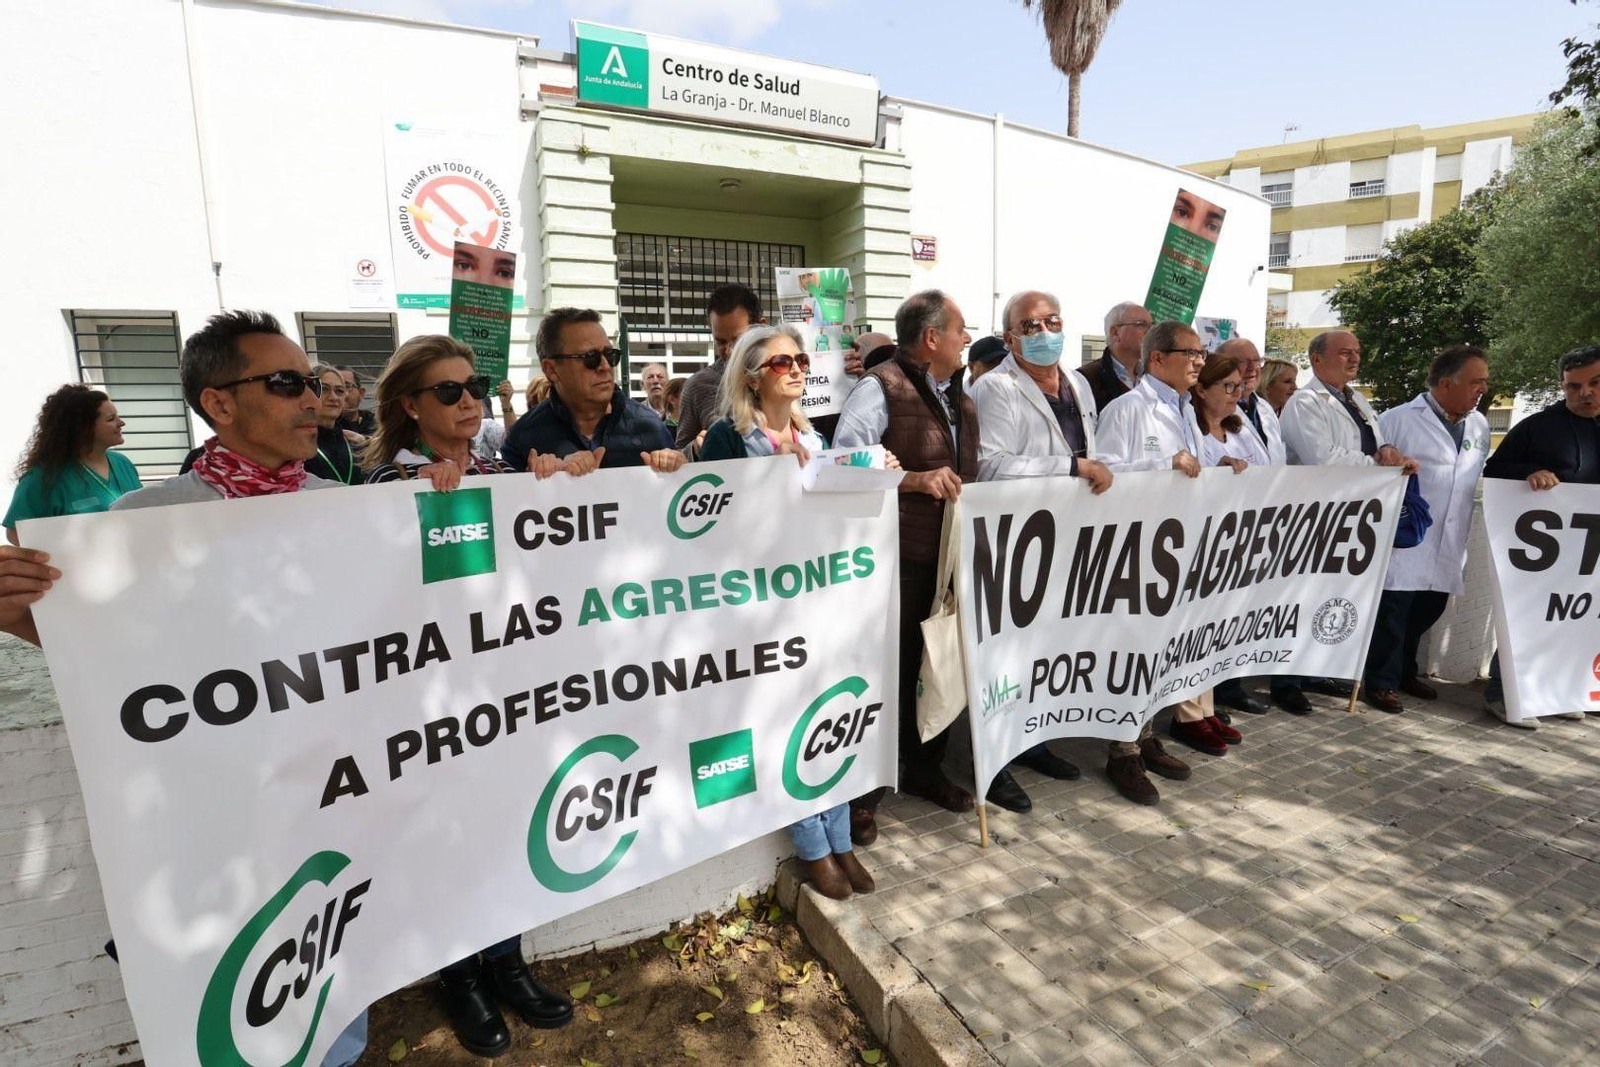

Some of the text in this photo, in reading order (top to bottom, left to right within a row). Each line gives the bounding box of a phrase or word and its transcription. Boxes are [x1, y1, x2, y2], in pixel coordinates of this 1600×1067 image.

[583, 75, 643, 90] Junta de Andalucía
[662, 57, 800, 96] Centro de Salud
[662, 85, 678, 101] La
[682, 89, 727, 110] Granja
[738, 97, 757, 113] Dr.
[760, 103, 807, 121] Manuel
[809, 109, 851, 128] Blanco
[427, 163, 442, 175] EN
[443, 162, 472, 174] TODO
[473, 169, 484, 182] EL
[401, 169, 429, 200] FUMAR
[484, 177, 511, 218] RECINTO
[399, 204, 431, 261] PROHIBIDO
[1172, 272, 1187, 286] NO
[471, 328, 490, 339] NO
[473, 348, 505, 360] LUCIÓN
[804, 375, 830, 386] TIFICA
[800, 394, 831, 407] RESIÓN
[680, 491, 733, 519] CSIF
[427, 502, 619, 551] SATSE CSIF
[972, 498, 1384, 645] NO MAS AGRESIONES
[1545, 592, 1593, 622] NO
[120, 546, 876, 743] CONTRA LAS AGRESIONES
[1029, 650, 1096, 704] POR
[1159, 615, 1241, 679] SANIDAD
[1235, 603, 1300, 646] DIGNA
[1211, 656, 1232, 677] DE
[1236, 649, 1293, 667] CÁDIZ
[320, 636, 808, 810] A PROFESIONALES
[803, 701, 883, 762] CSIF
[697, 753, 750, 781] SATSE
[555, 764, 658, 843] CSIF
[244, 877, 372, 1029] CSIF
